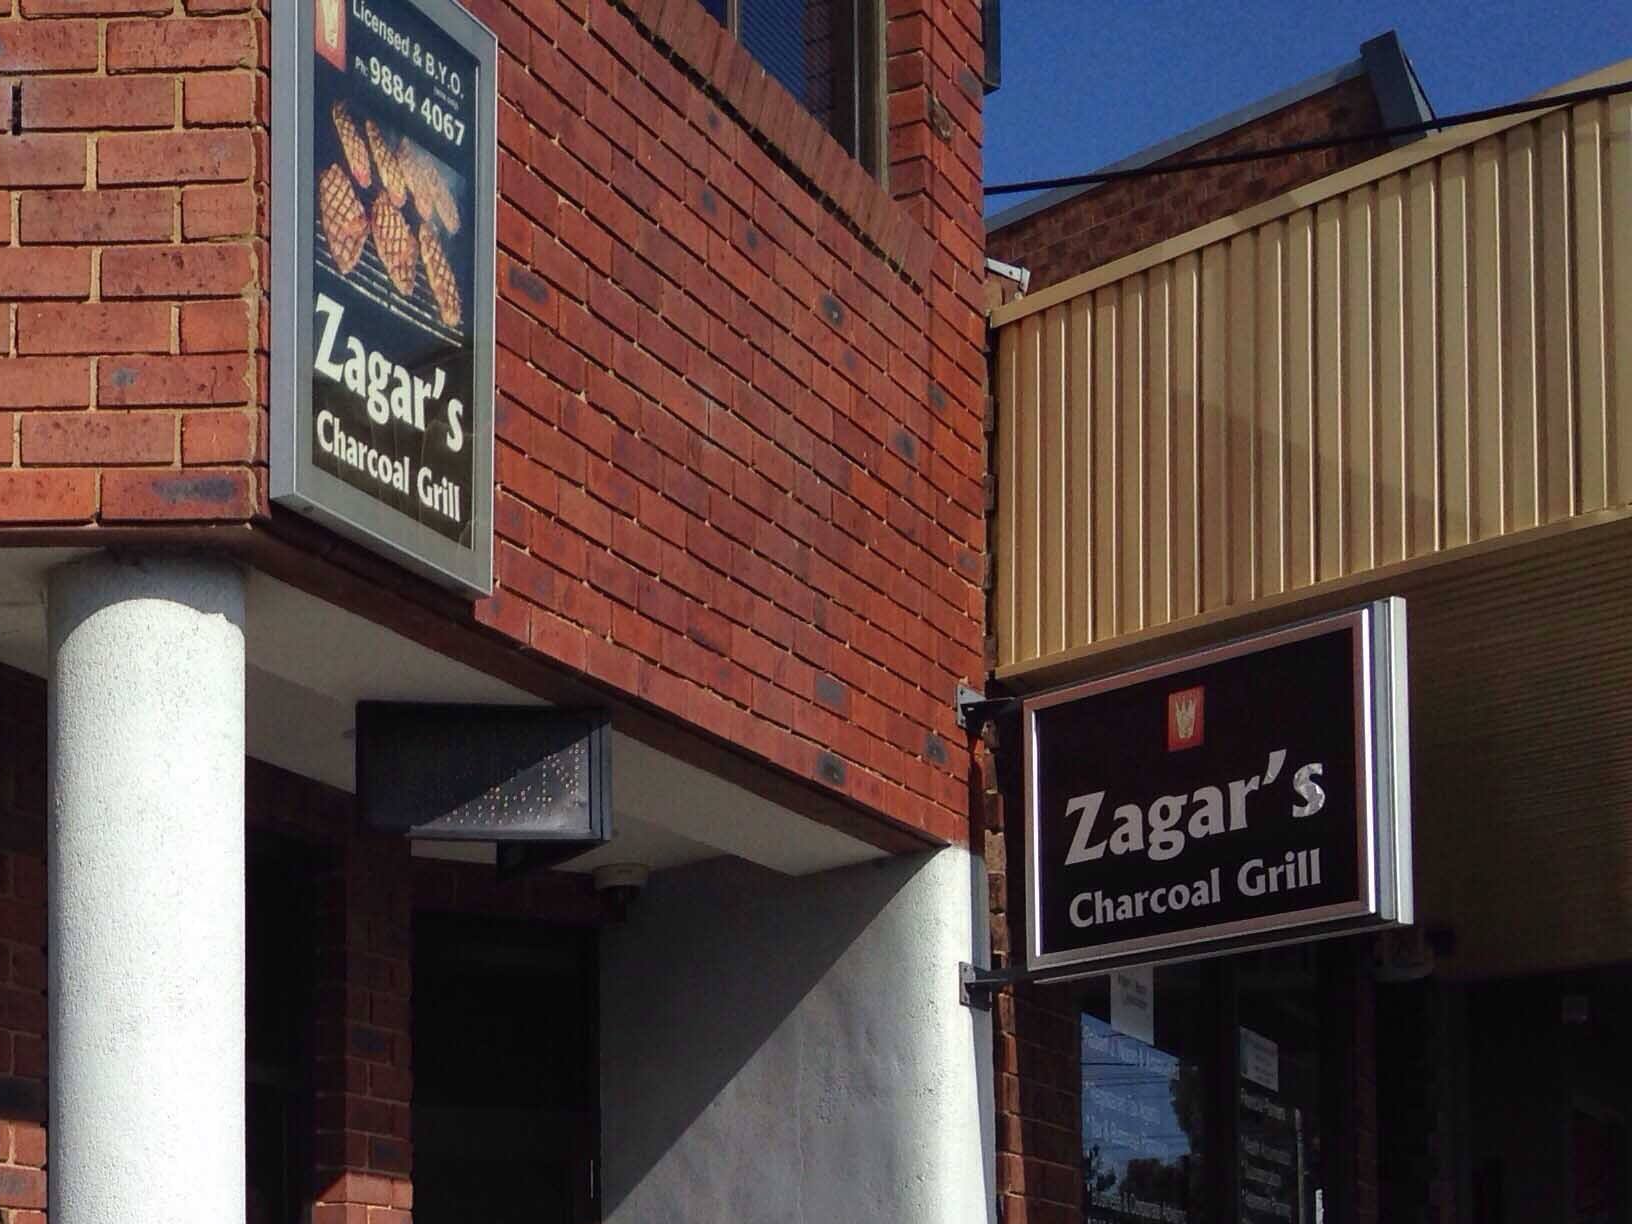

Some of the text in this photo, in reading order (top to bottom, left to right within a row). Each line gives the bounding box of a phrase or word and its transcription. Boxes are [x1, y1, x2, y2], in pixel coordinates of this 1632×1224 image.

[353, 0, 409, 59] Licensed
[412, 43, 423, 67] &
[425, 52, 465, 99] B.Y.O.
[370, 56, 416, 112] 9884
[421, 97, 465, 146] 4067
[315, 293, 464, 454] Zagar's
[316, 408, 461, 523] Charcoal Grill
[1064, 749, 1326, 865] Zagar's
[1069, 848, 1322, 928] Charcoal Grill
